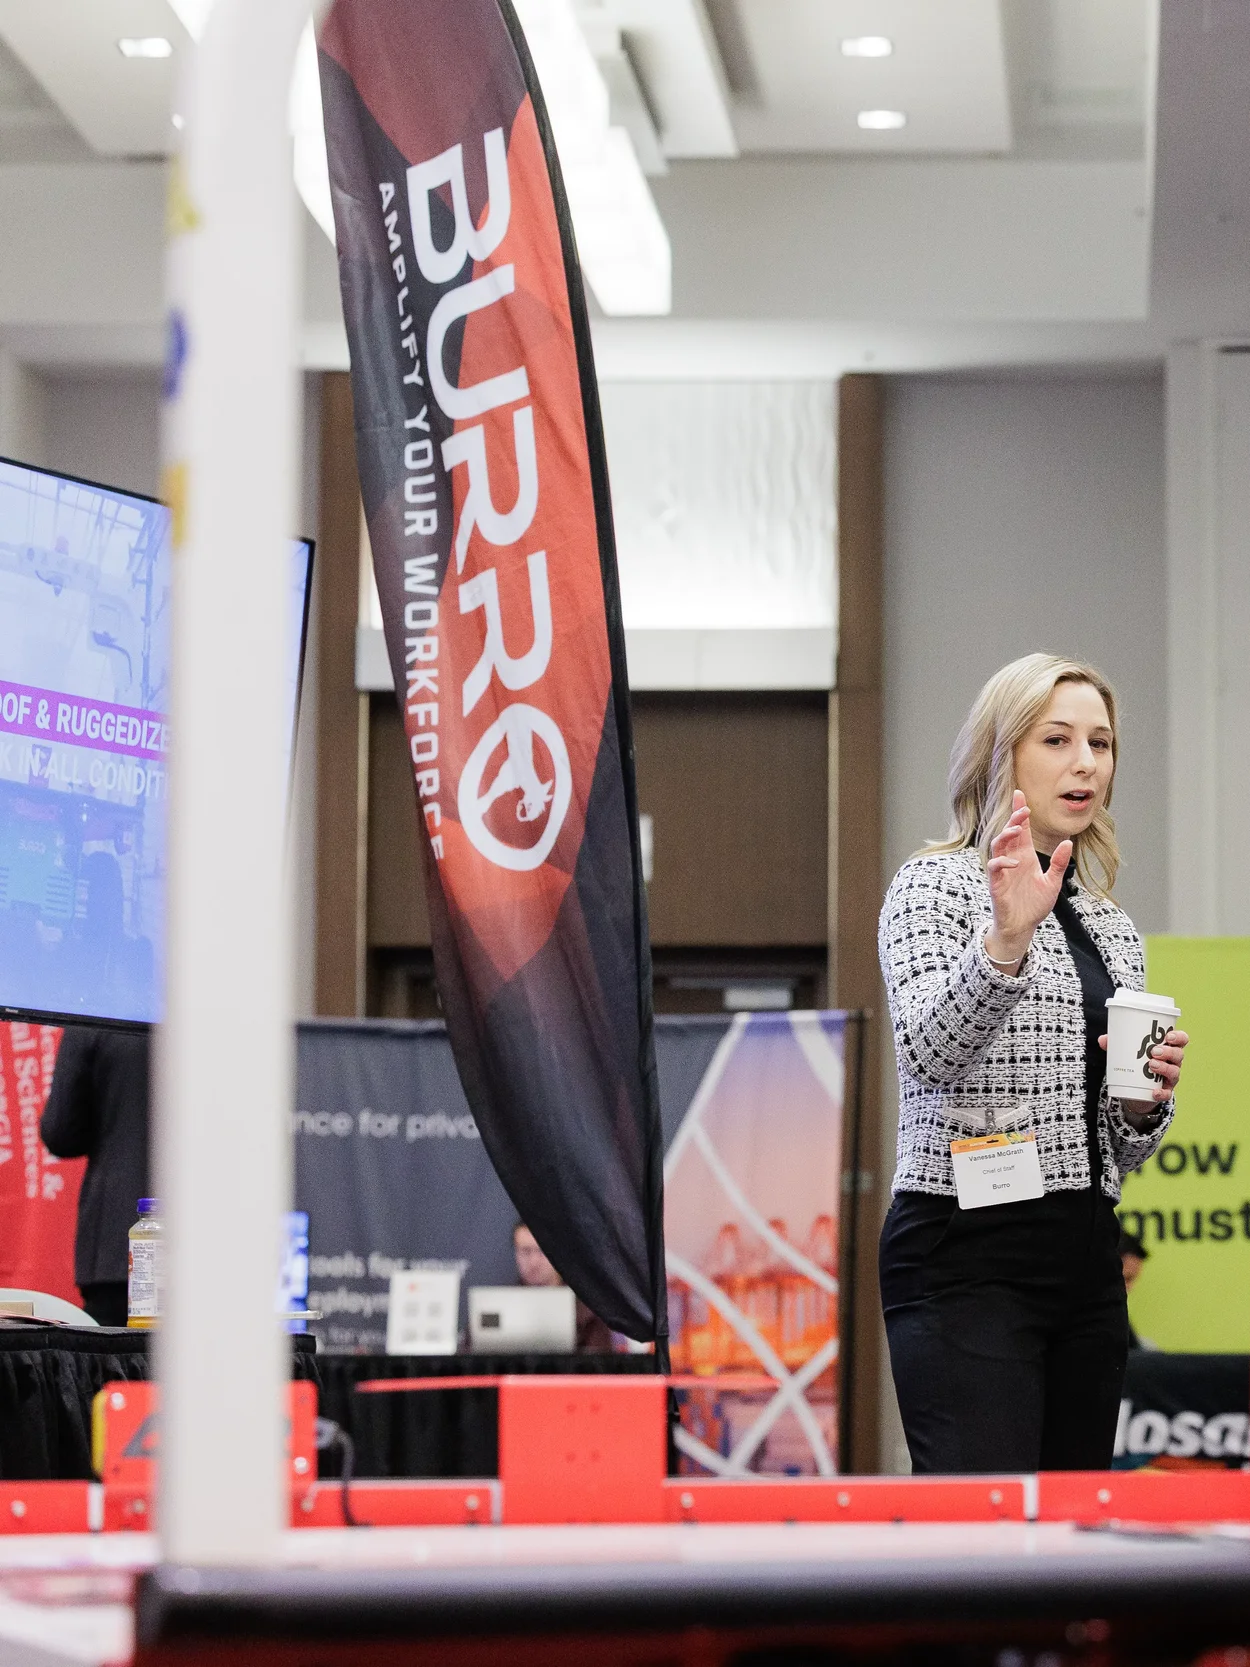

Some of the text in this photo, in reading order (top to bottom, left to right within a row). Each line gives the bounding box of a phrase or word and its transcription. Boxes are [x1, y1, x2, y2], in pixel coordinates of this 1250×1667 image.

[379, 182, 425, 387] AMPLIFY
[403, 405, 439, 537] YOUR
[406, 126, 572, 871] BURRO
[0, 692, 32, 725] OF
[35, 699, 51, 730] &
[44, 752, 83, 785] ALL
[359, 1107, 400, 1138] for
[968, 1148, 1024, 1162] Vanessa McGrath
[982, 1167, 996, 1175] Chief
[992, 1182, 1011, 1190] Burro
